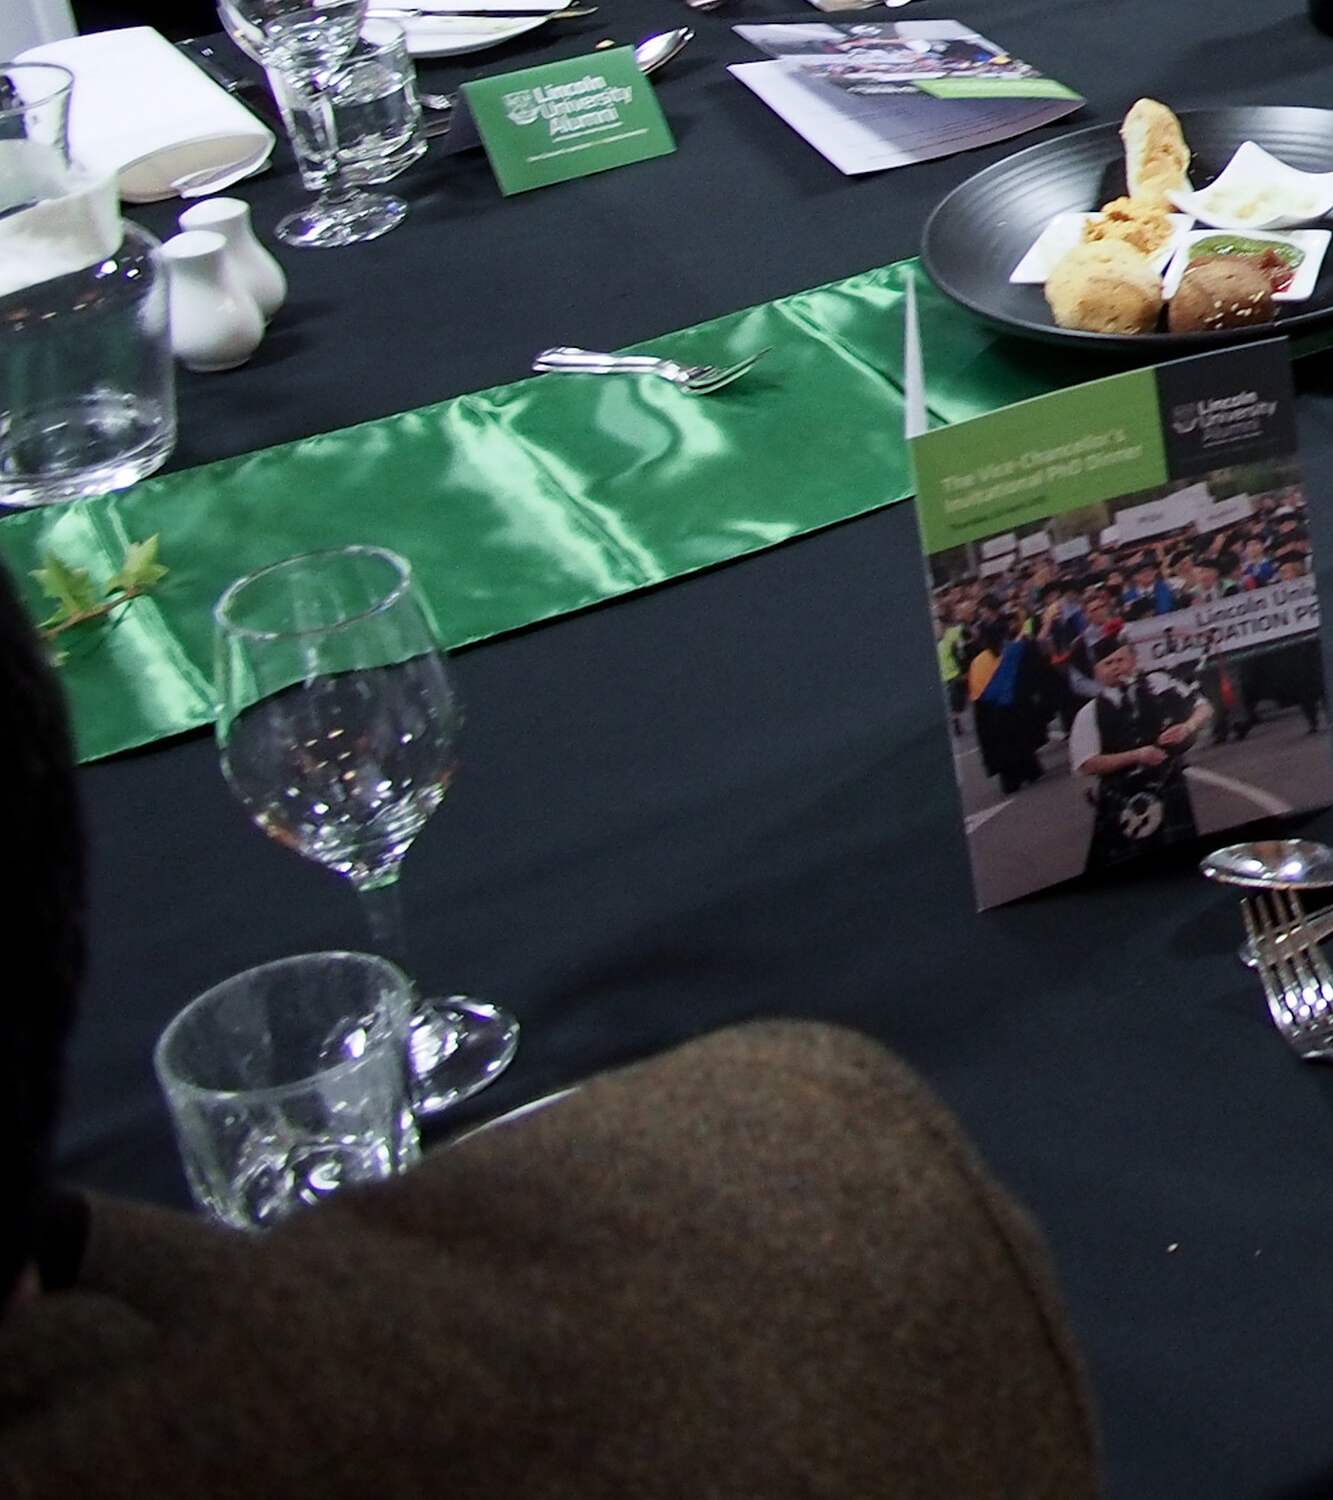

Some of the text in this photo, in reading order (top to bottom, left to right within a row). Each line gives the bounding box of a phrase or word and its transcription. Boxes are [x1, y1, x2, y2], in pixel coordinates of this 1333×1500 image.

[532, 75, 607, 104] Lincoln
[540, 86, 633, 119] University
[549, 104, 620, 137] Alumni
[1197, 390, 1258, 416] Lincoln
[1199, 401, 1279, 429] University
[1196, 597, 1267, 627] Lincoln
